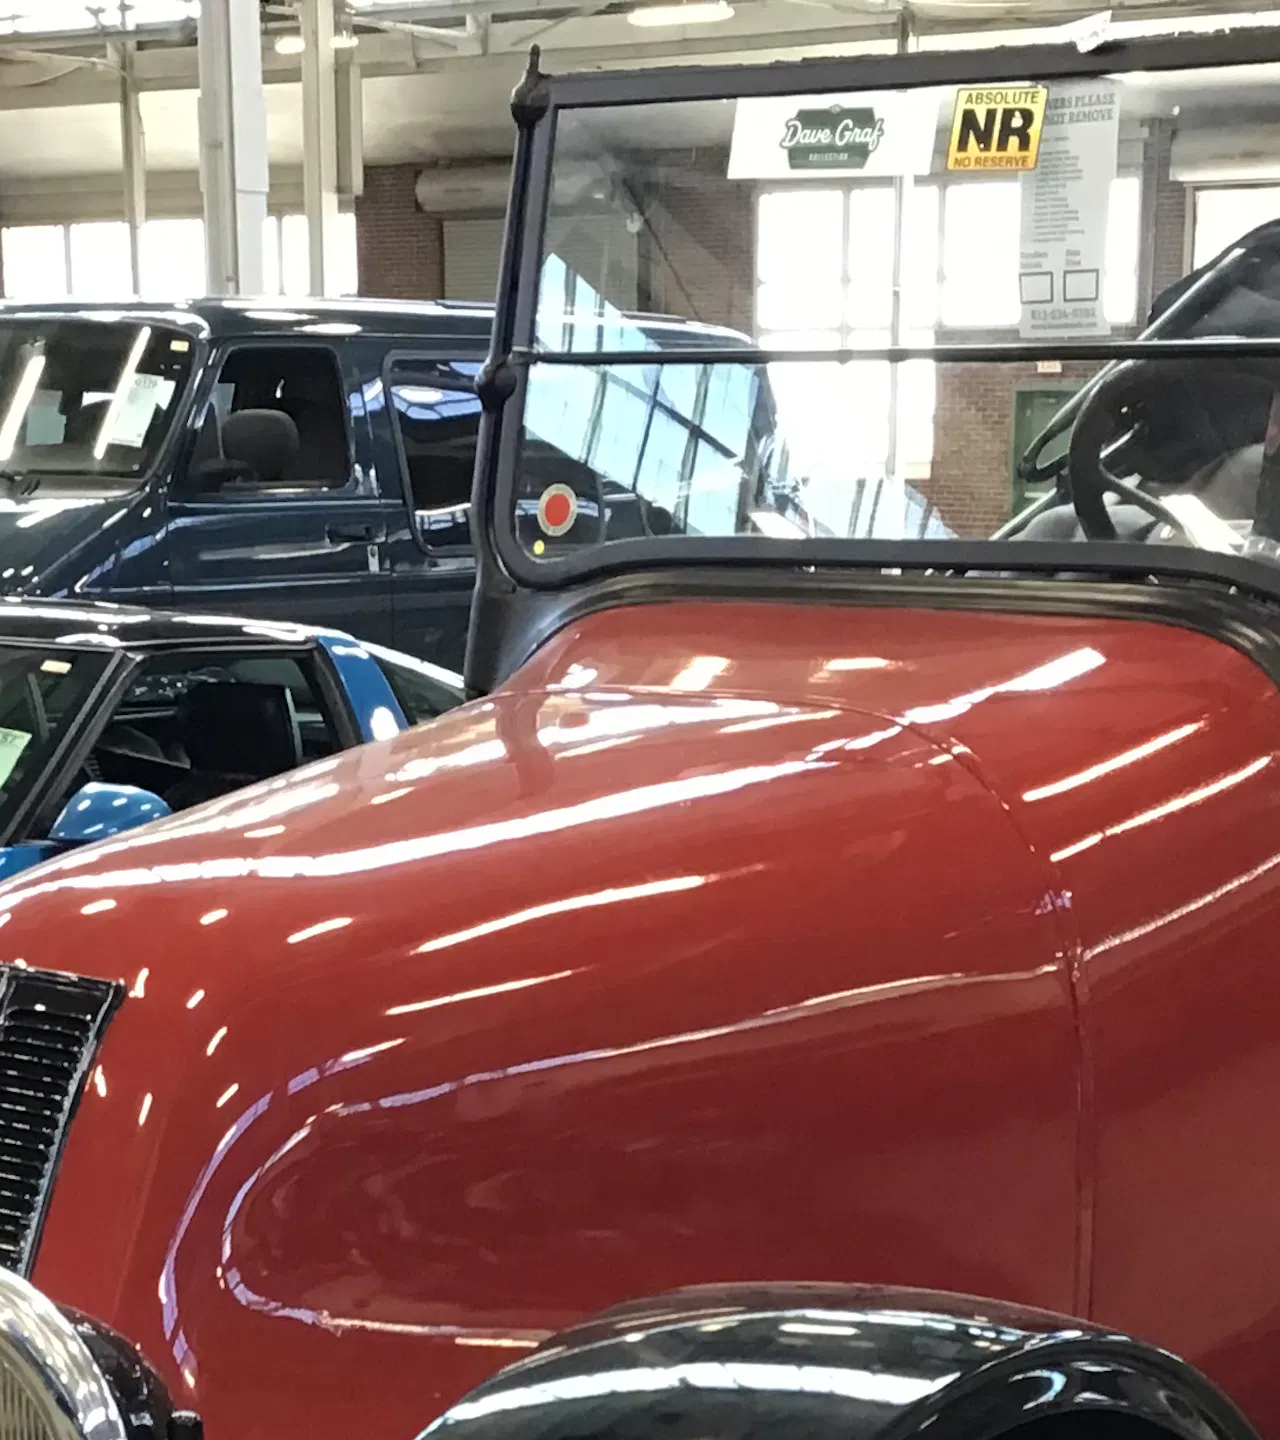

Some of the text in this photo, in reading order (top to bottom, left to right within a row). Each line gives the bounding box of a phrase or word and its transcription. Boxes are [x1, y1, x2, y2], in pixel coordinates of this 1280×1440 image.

[965, 91, 1040, 105] ABSOLUTE
[1069, 108, 1113, 122] REMOVE
[780, 117, 884, 151] Dave Graf
[956, 107, 1035, 153] NR
[953, 155, 1030, 168] NO RESERVE
